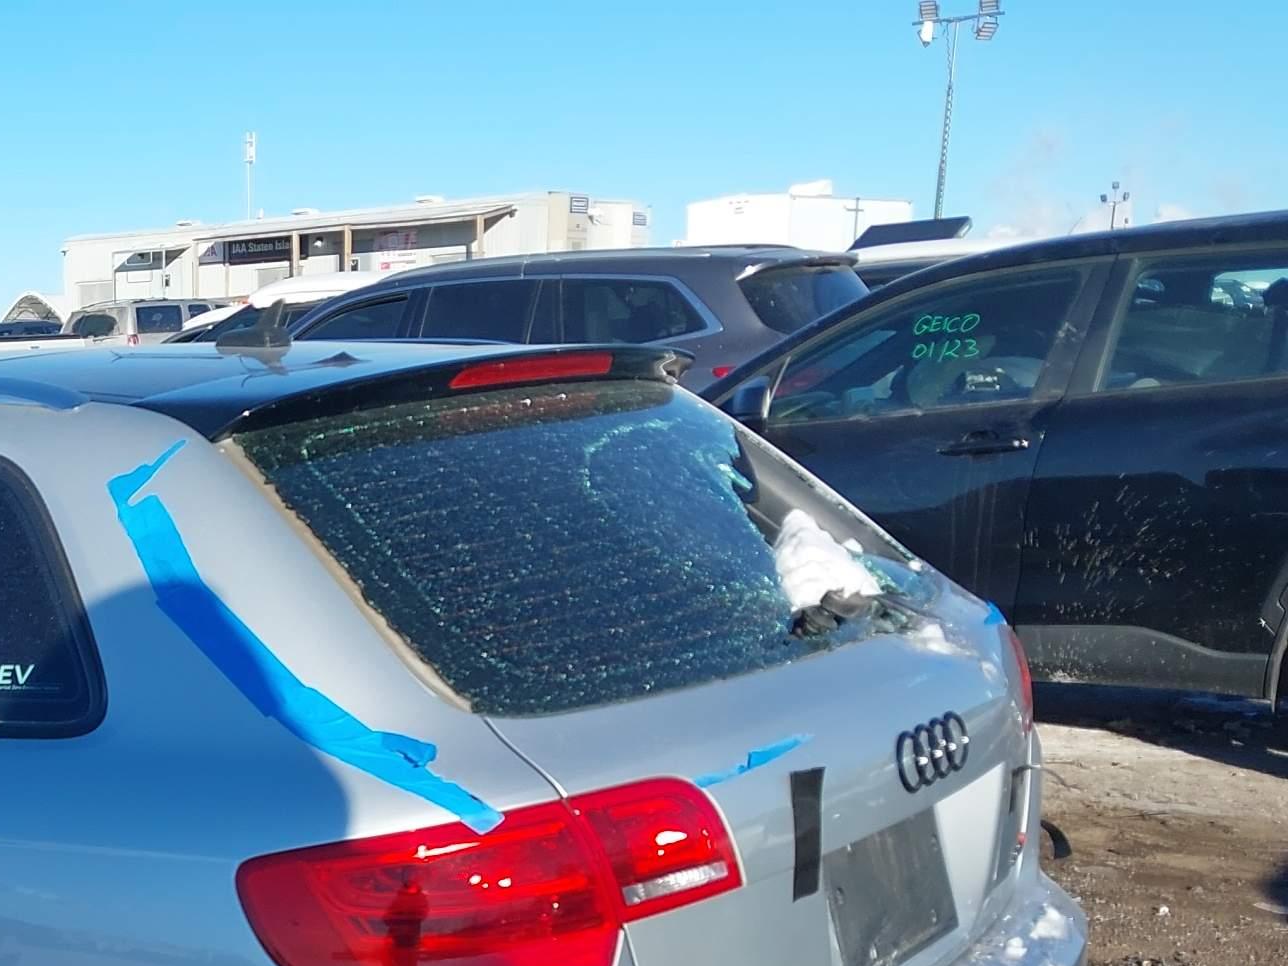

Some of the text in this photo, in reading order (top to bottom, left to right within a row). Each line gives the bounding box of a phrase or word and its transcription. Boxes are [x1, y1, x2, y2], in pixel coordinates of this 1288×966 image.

[232, 238, 292, 254] IAA Staten Isla
[913, 313, 981, 335] GEICO
[912, 339, 980, 362] 01/23
